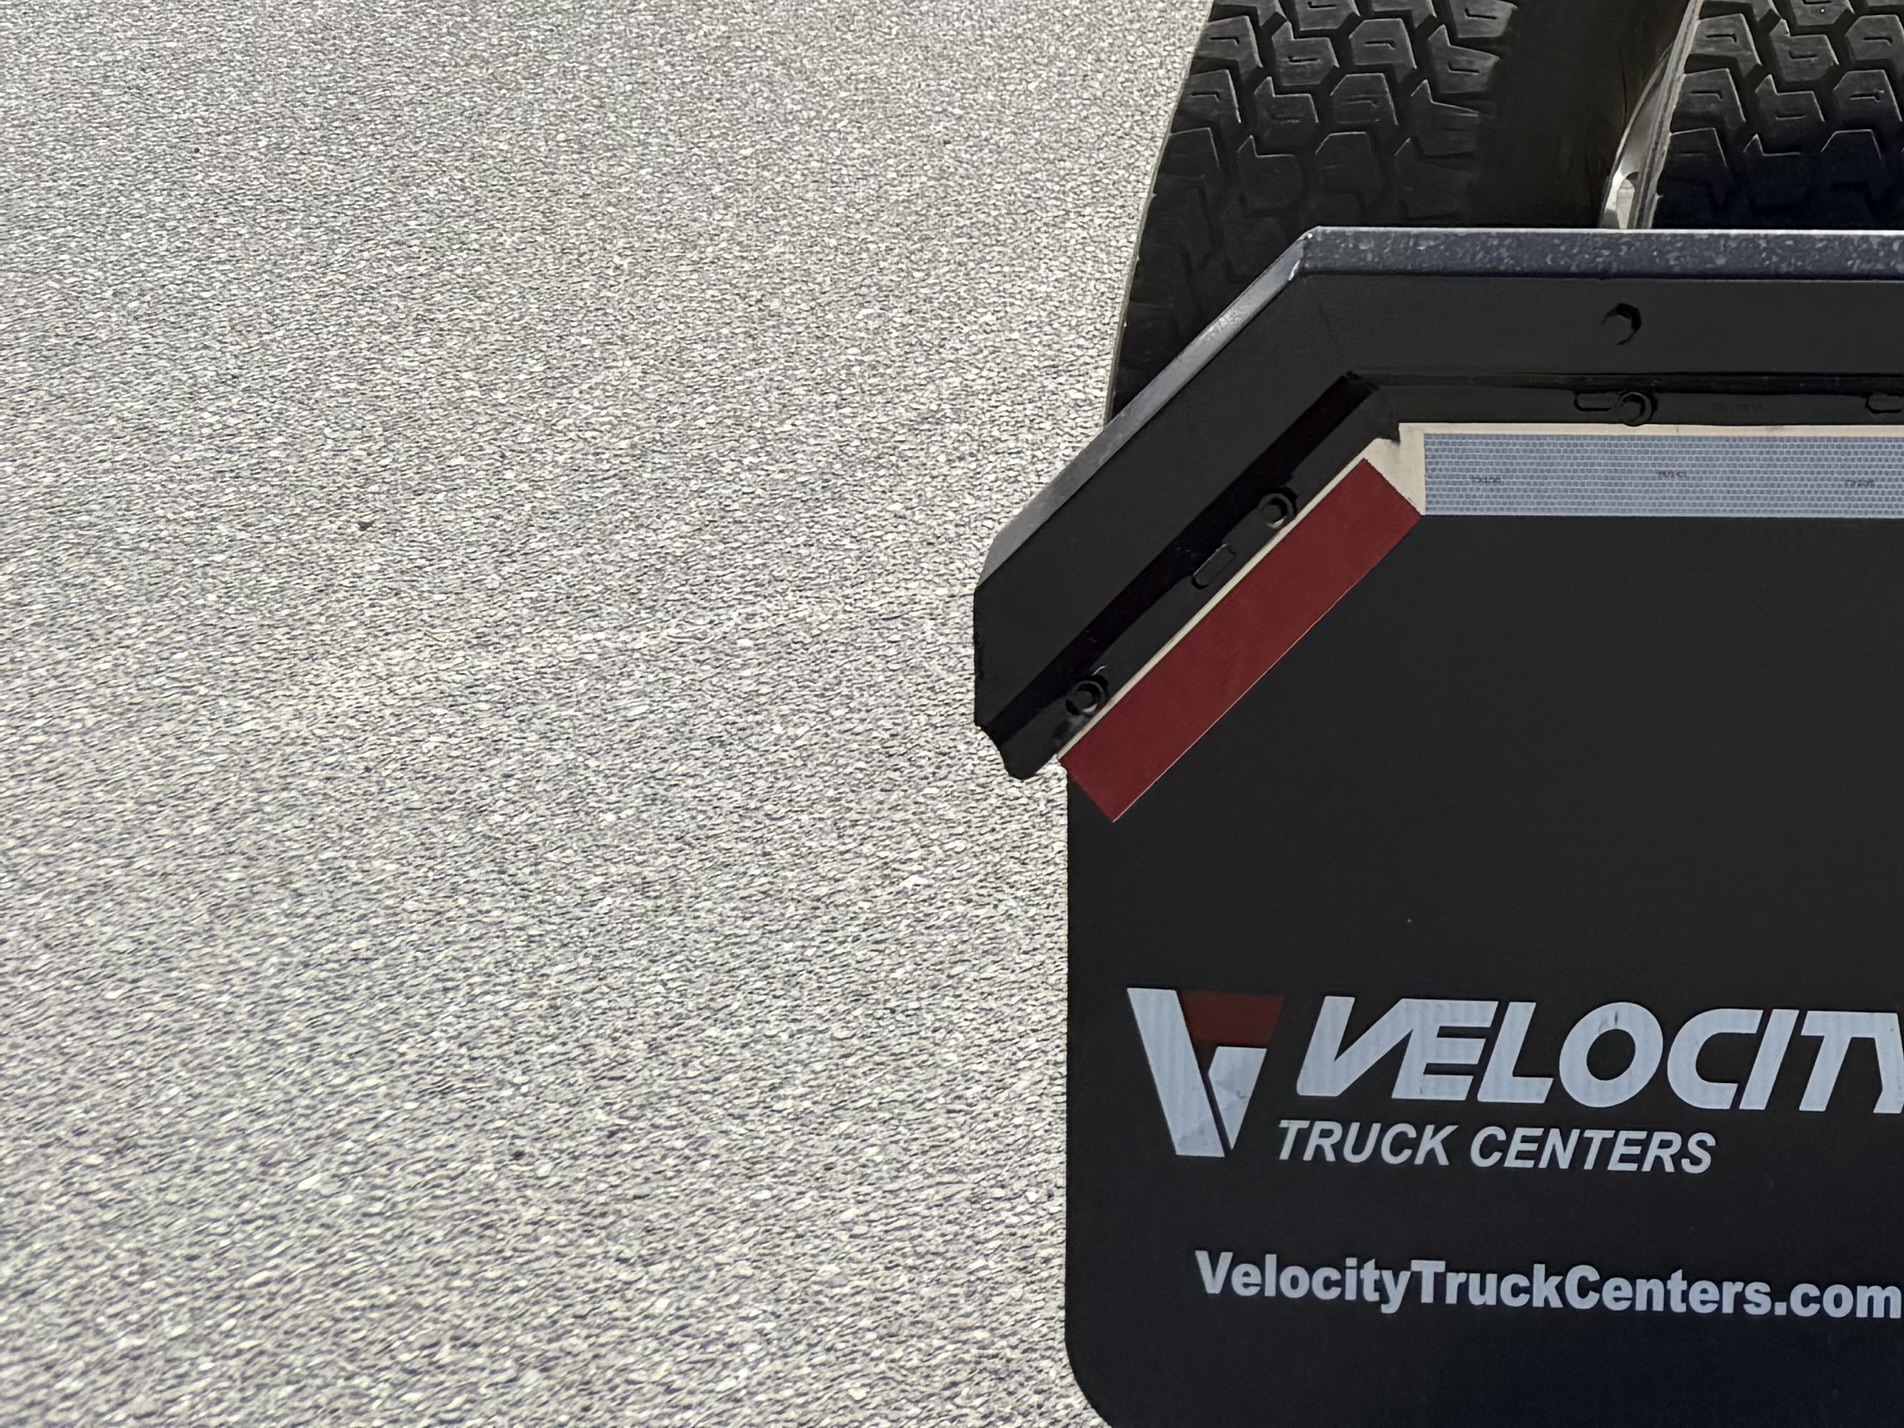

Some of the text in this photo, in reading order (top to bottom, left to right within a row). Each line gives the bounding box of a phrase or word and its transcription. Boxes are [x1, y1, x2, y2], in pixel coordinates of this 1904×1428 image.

[1278, 1119, 1716, 1174] TRUCK CENTERS
[1195, 1250, 1902, 1319] VelocityTruckCenters.com
